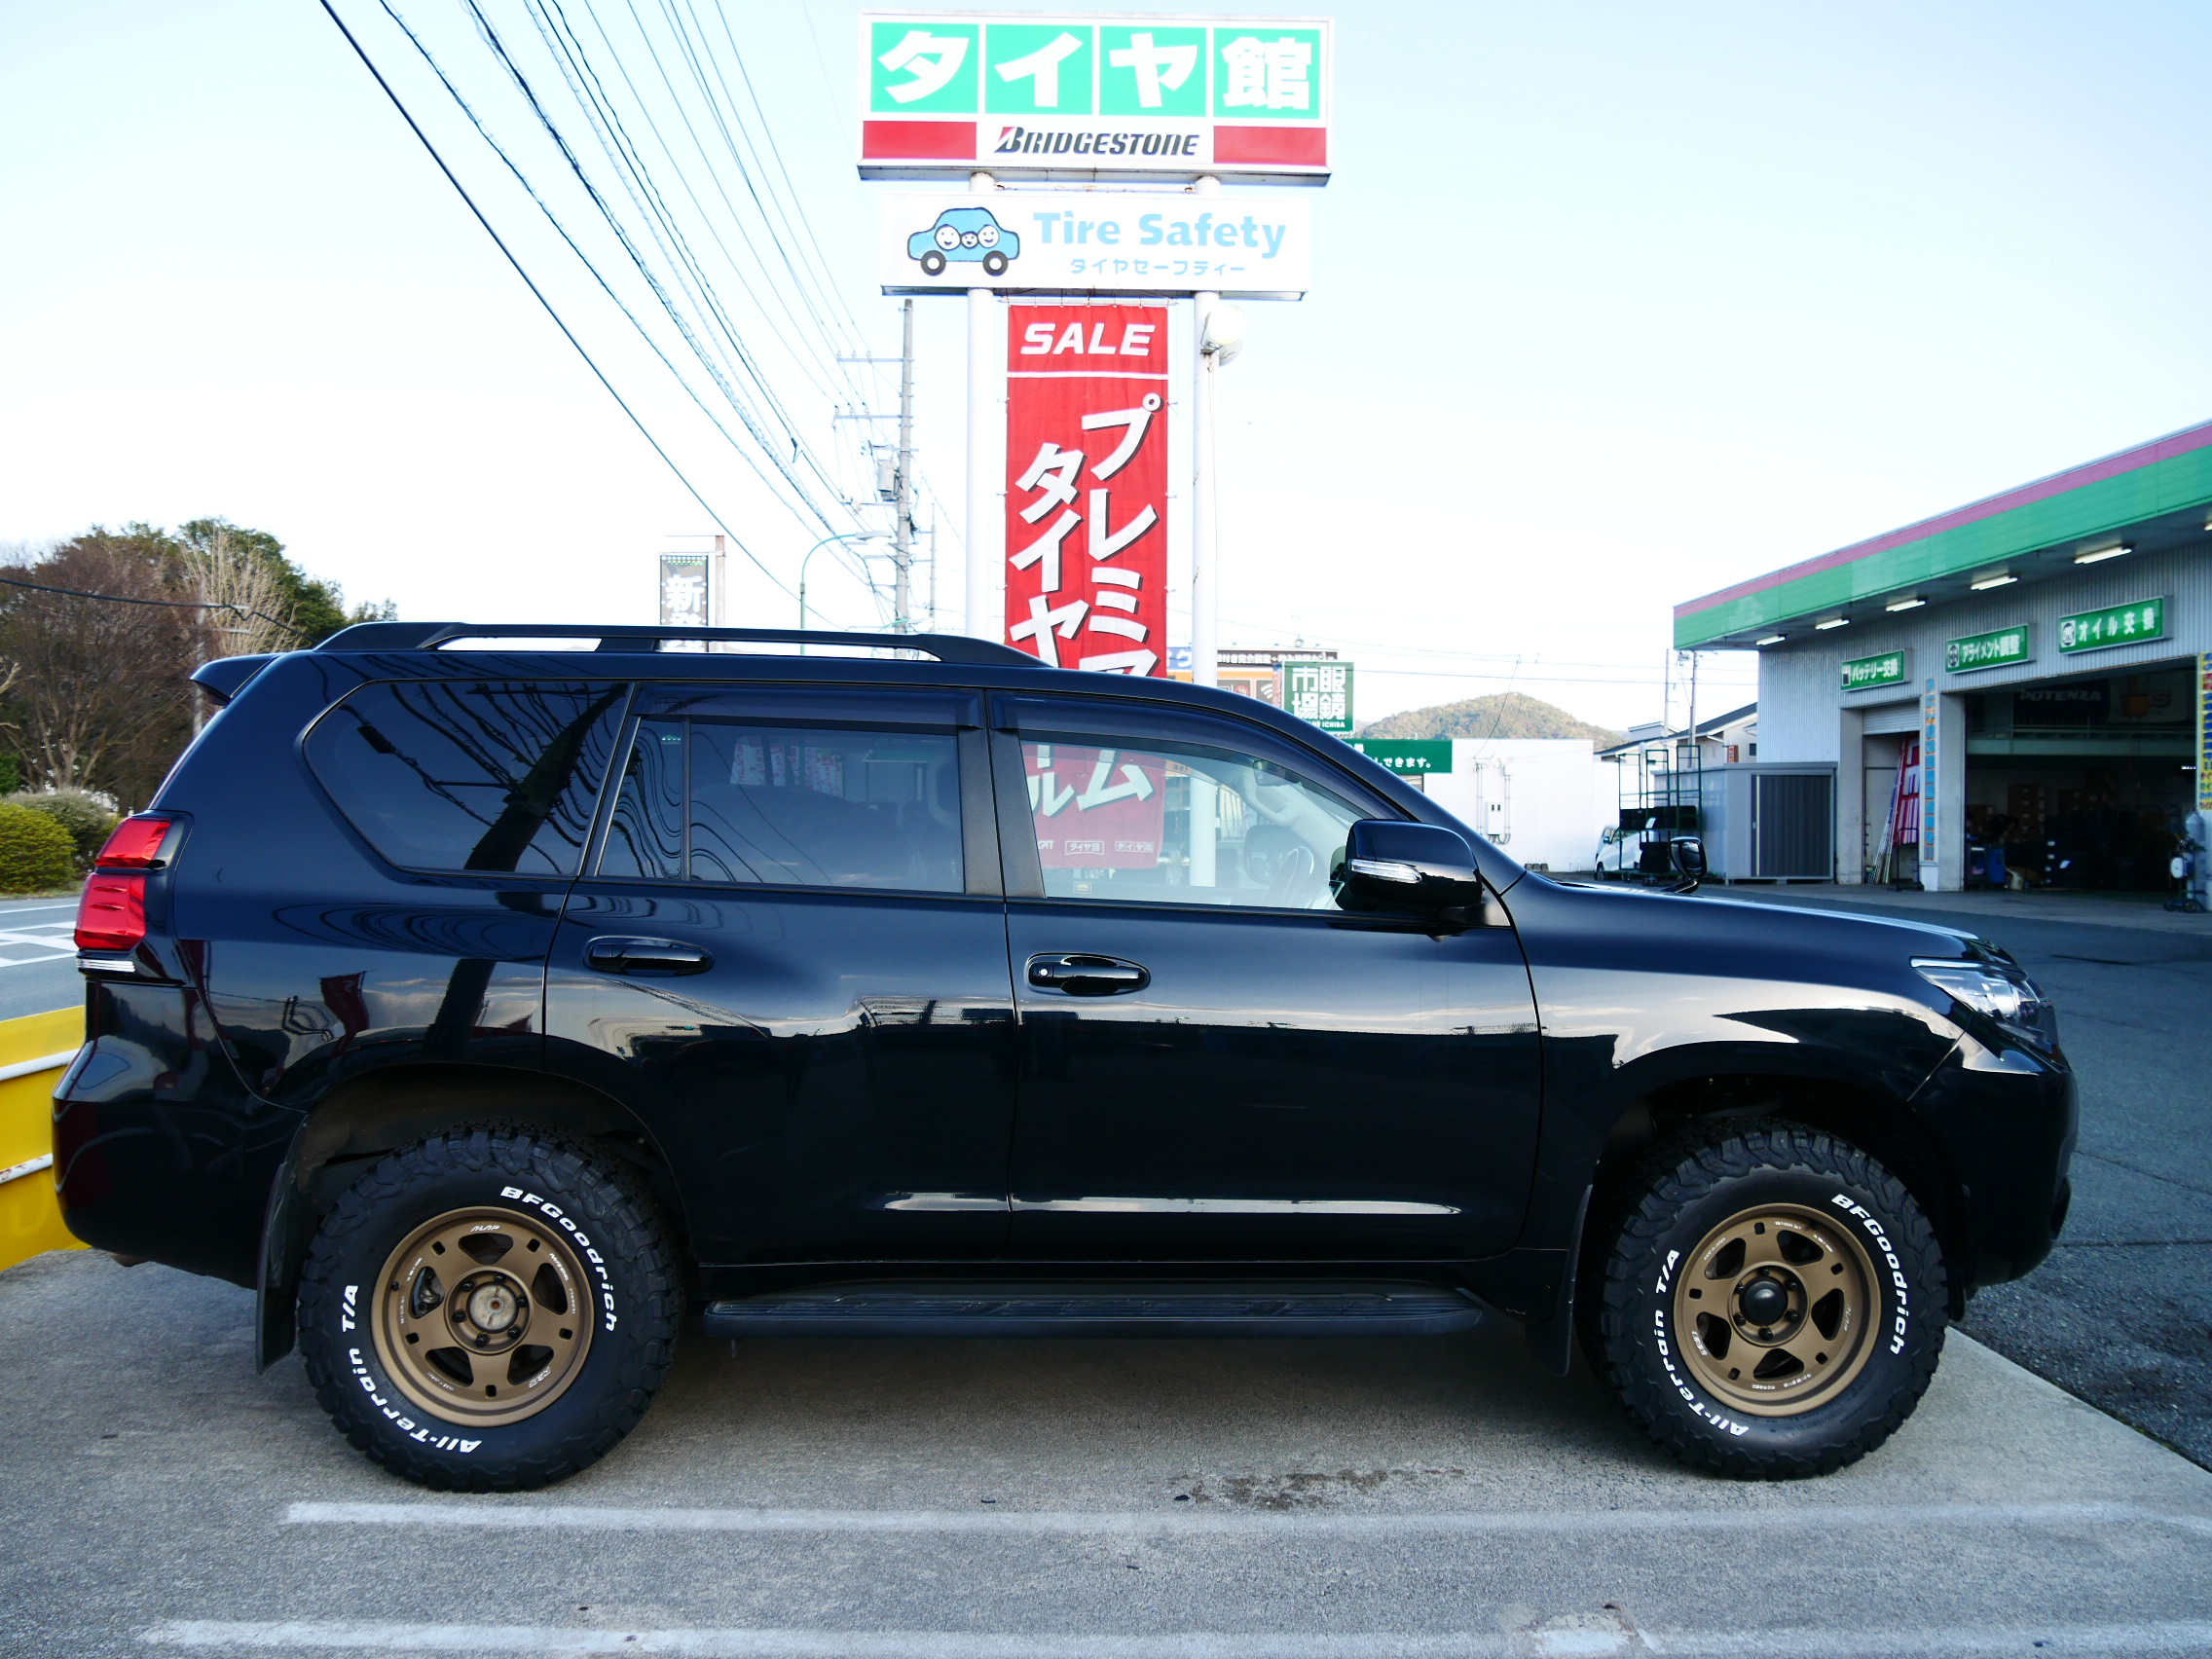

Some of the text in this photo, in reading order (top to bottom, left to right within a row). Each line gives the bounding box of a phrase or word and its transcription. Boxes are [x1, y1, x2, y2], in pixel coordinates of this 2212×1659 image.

[878, 30, 1312, 111] タイヤ館
[994, 126, 1200, 157] BRIDGESTONE
[1033, 211, 1286, 259] Tire Safety
[1070, 258, 1246, 276] タイヤセーフティー
[1020, 322, 1156, 356] SALE
[2079, 608, 2156, 642] オイル交換
[1962, 635, 2020, 663] アライメント調整
[1852, 658, 1899, 682] バッテリー交換
[2020, 689, 2103, 702] POTENZA
[500, 1185, 618, 1332] BFGoodrich
[1831, 1194, 1909, 1355] BFGoodrich
[1653, 1249, 1750, 1437] All-Terrain T/A
[342, 1285, 482, 1454] All-Terrain T/A
